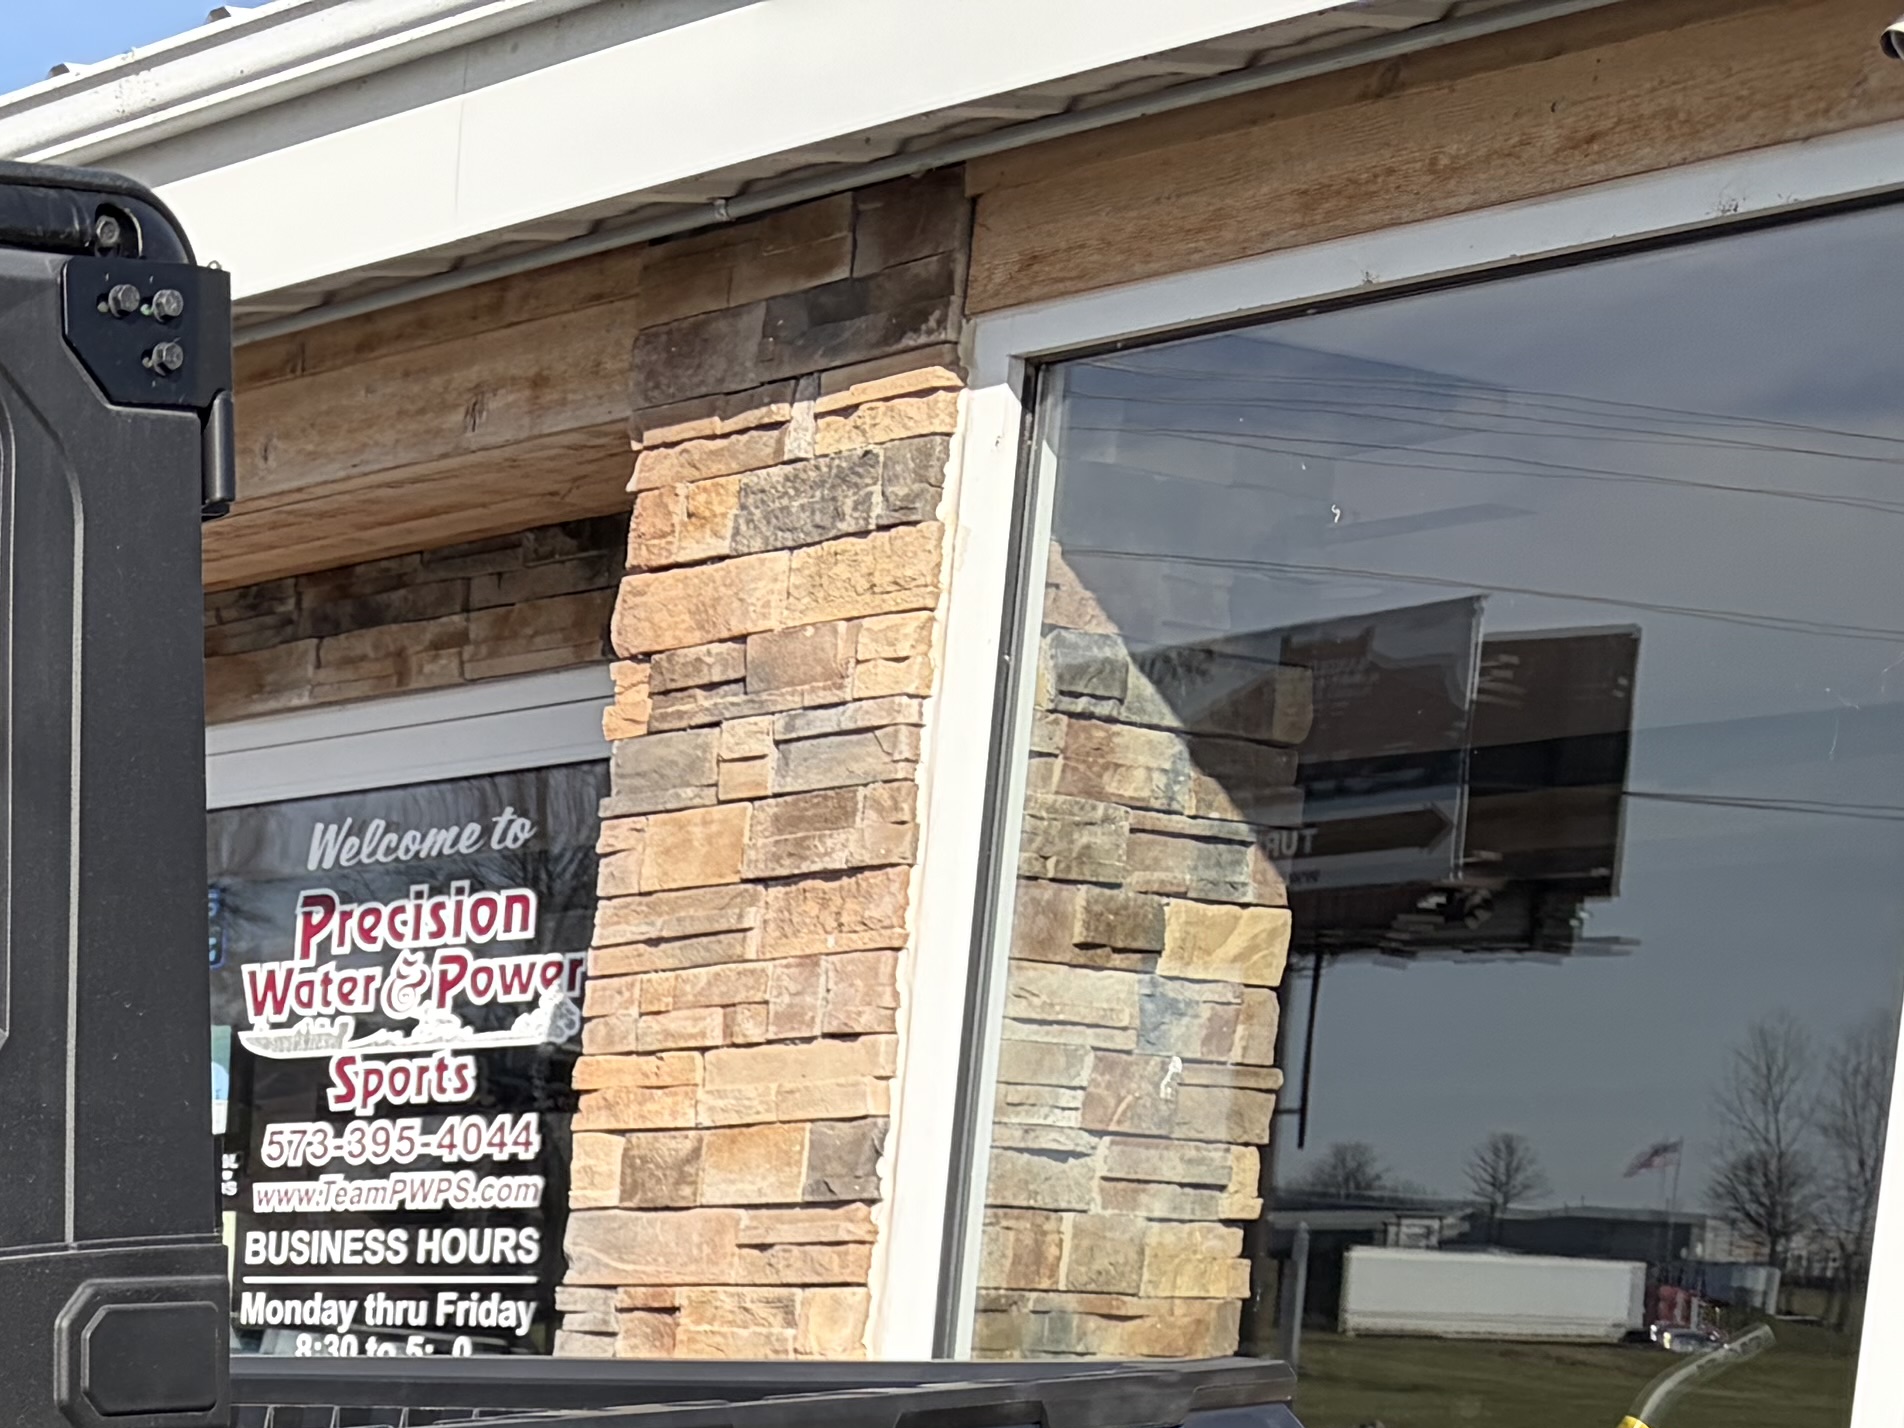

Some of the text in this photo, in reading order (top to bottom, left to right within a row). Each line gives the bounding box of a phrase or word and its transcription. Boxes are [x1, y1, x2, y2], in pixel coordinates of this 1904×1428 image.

[307, 806, 536, 871] Welcome to
[295, 880, 537, 965] Precision
[242, 948, 586, 1023] Water & Power
[327, 1051, 476, 1115] Sports
[261, 1113, 539, 1168] 573-395-4044
[253, 1171, 545, 1212] www.TeamPWPS.com
[244, 1228, 540, 1264] BUSINESS HOURS
[240, 1292, 537, 1335] Monday thru Friday
[295, 1333, 358, 1357] 8:30
[365, 1336, 396, 1357] to
